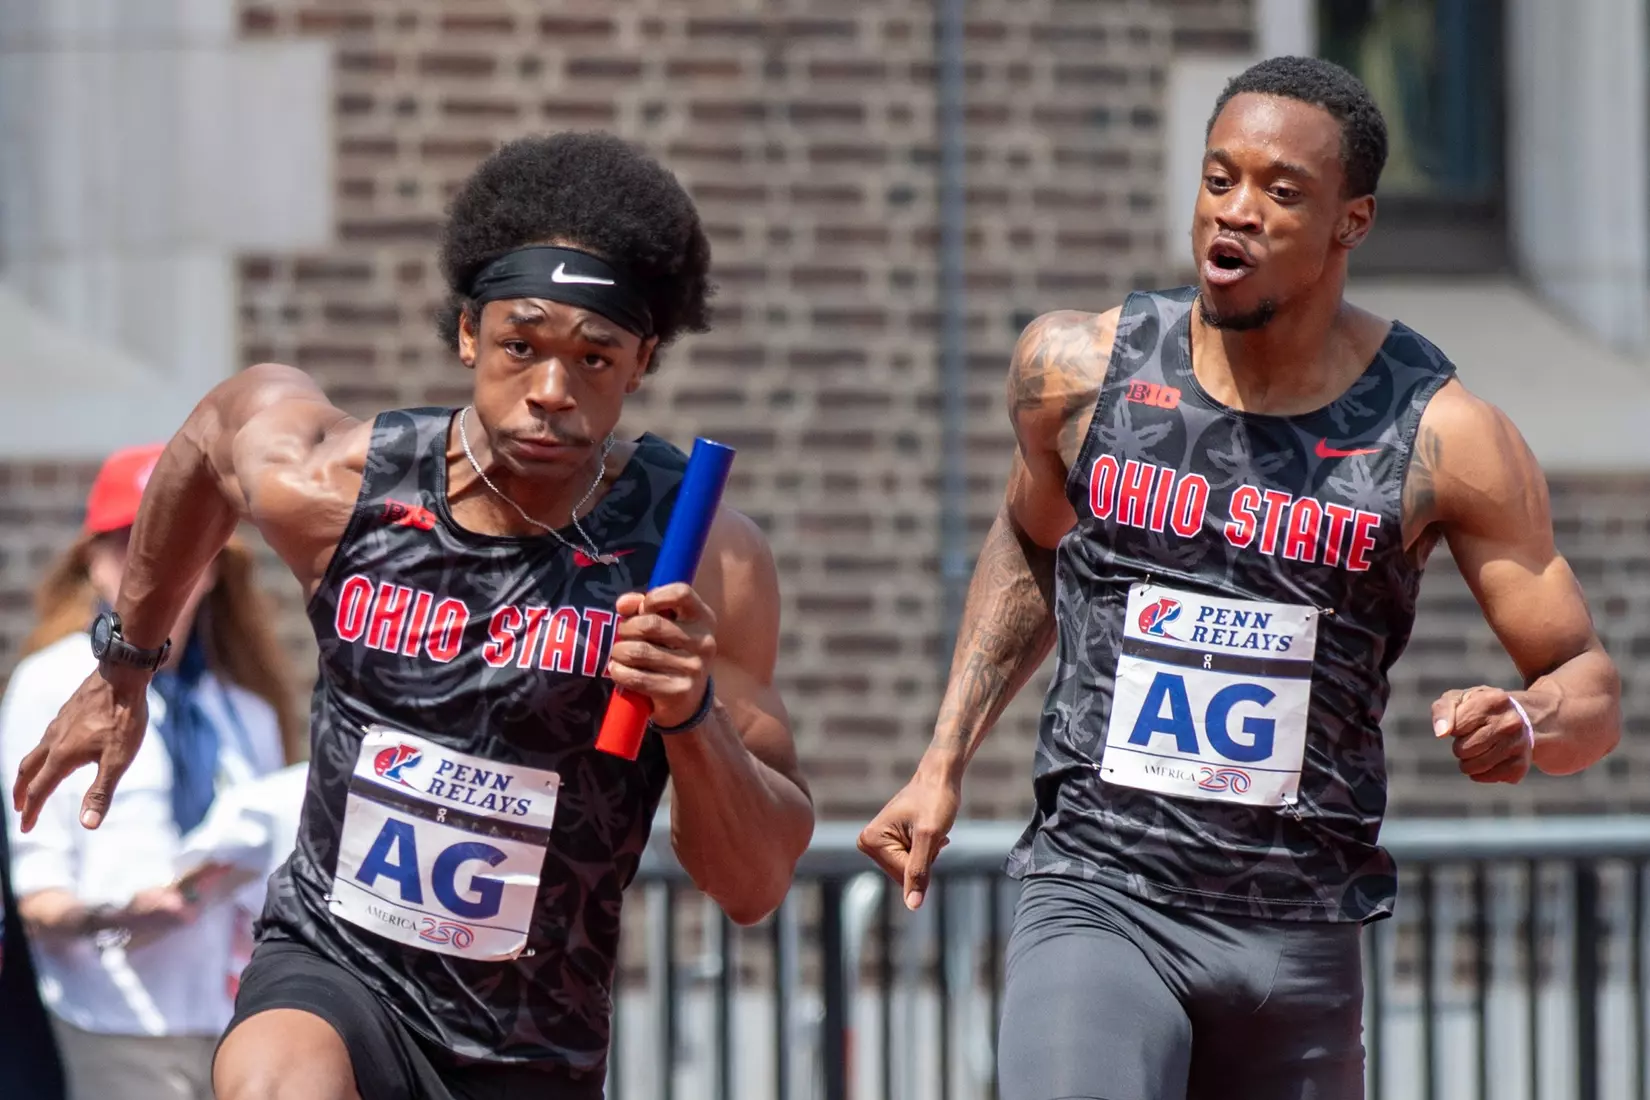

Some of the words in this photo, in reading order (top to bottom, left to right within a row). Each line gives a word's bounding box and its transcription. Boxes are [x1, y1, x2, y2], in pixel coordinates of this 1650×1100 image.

[1089, 454, 1210, 538] OHIO
[1224, 484, 1381, 572] STATE
[335, 574, 470, 663] OHIO
[482, 604, 622, 679] STAT
[1189, 625, 1293, 652] RELAYS
[1196, 606, 1273, 630] PENN
[1127, 671, 1277, 763] AG
[435, 759, 514, 793] PENN
[1144, 764, 1196, 781] AMERICA
[1198, 767, 1252, 795] 250
[426, 778, 532, 817] RELAYS
[355, 817, 508, 920] AG
[366, 905, 418, 931] AMERICA
[419, 917, 475, 949] 250
